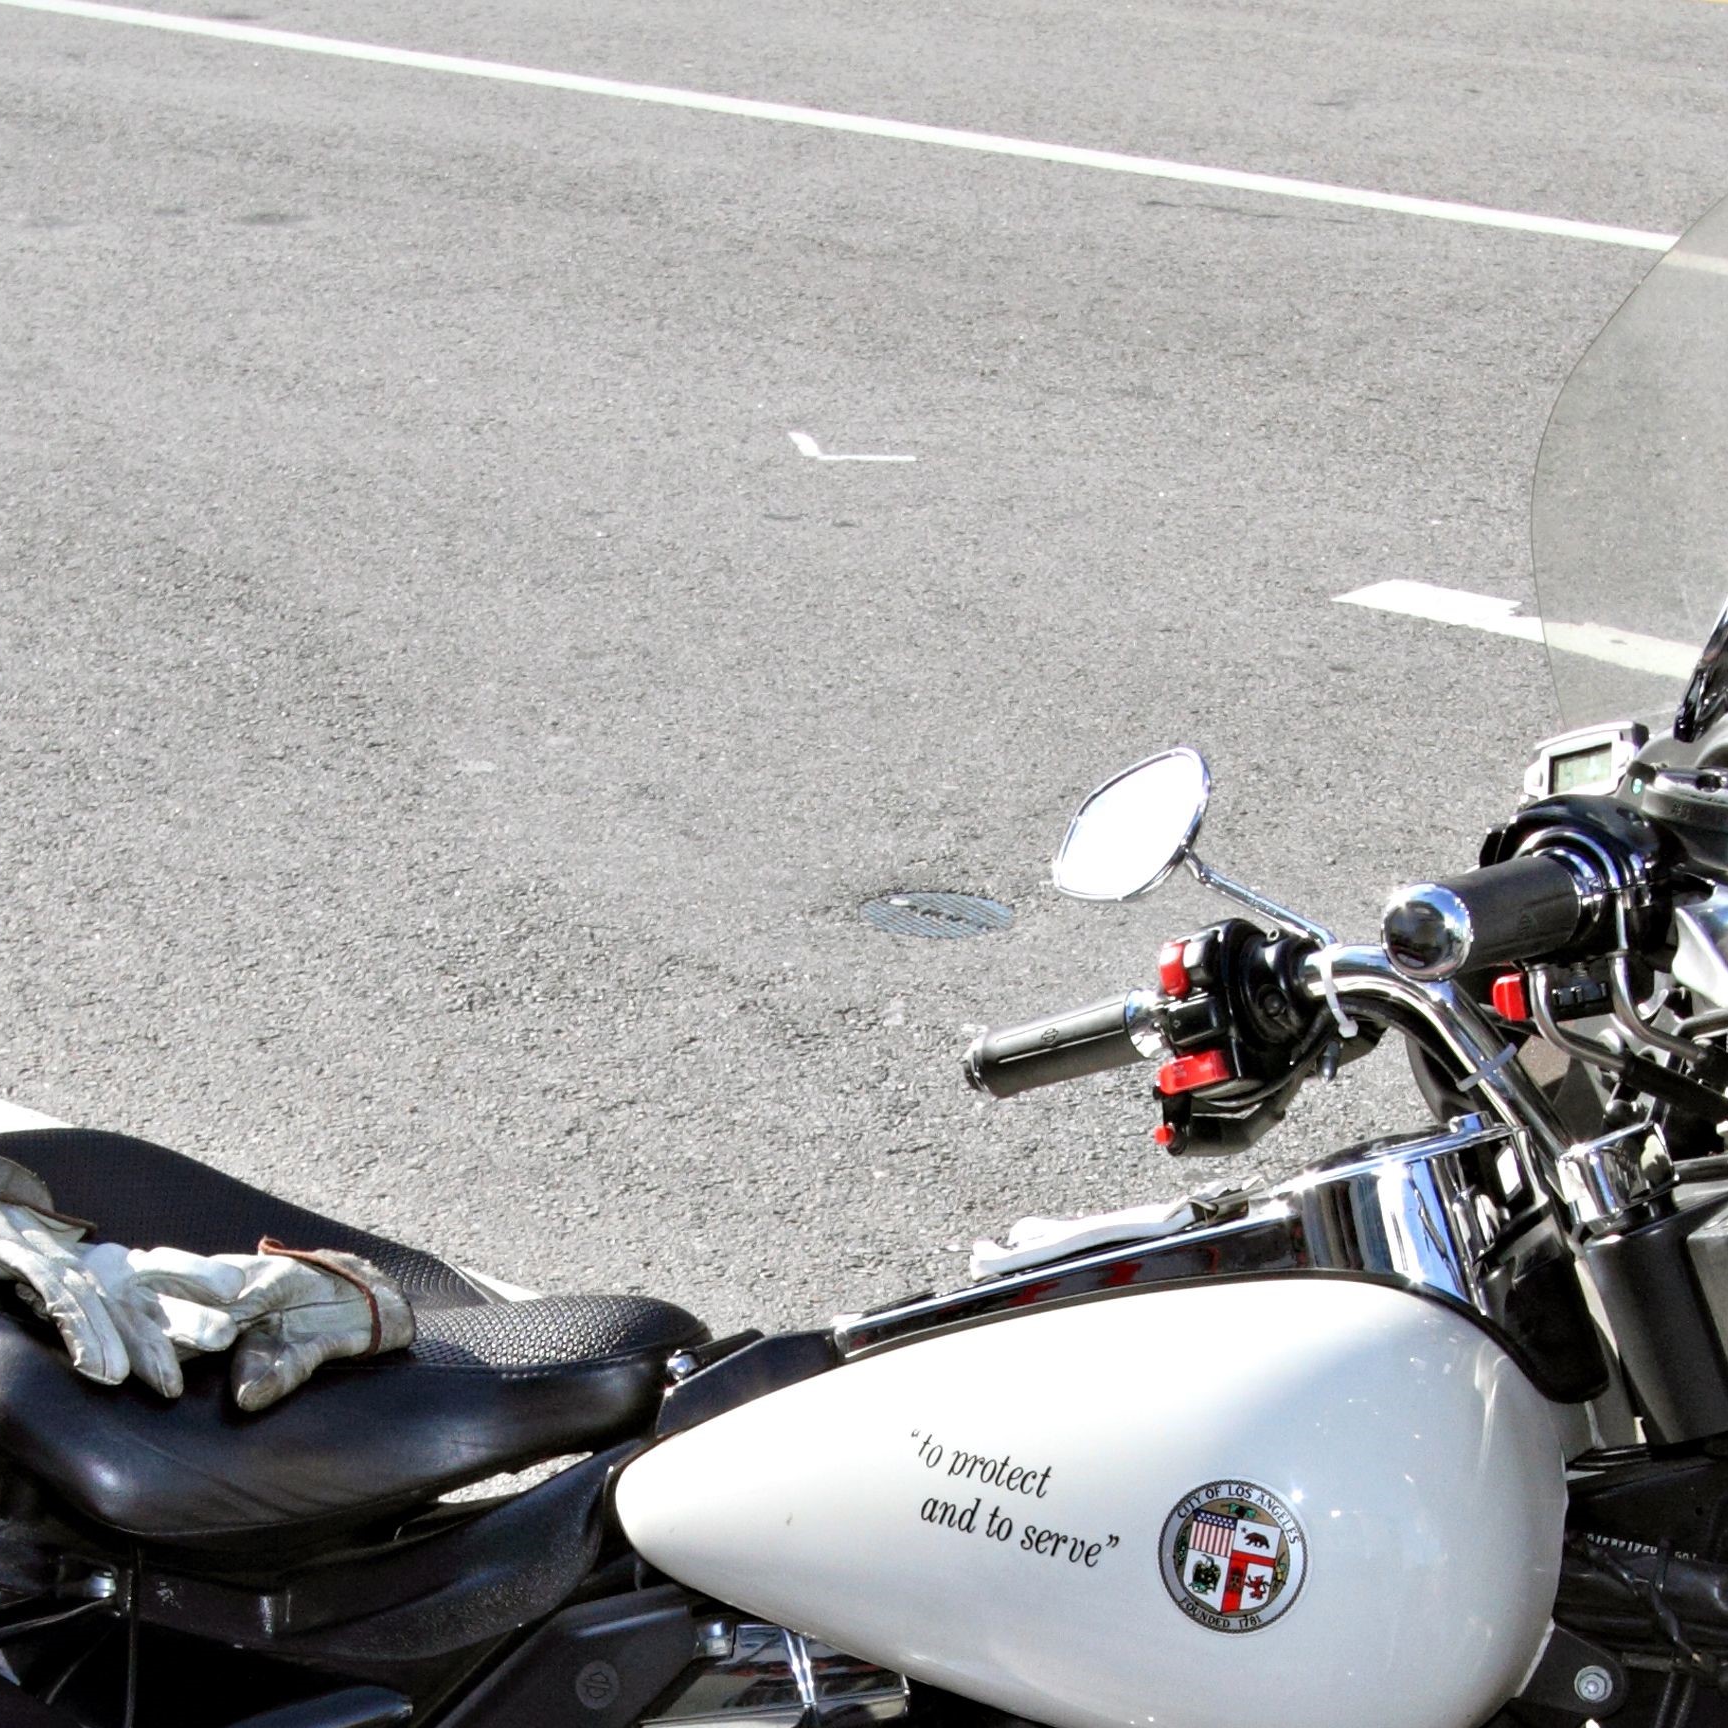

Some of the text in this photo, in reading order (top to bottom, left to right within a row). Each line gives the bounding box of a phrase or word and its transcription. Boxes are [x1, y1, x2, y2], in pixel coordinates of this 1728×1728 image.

[947, 1450, 1052, 1498] protect
[921, 1498, 981, 1533] and
[986, 1506, 1013, 1541] to
[1177, 1484, 1300, 1544] CITY OF LOS ANGELES
[1178, 1596, 1262, 1630] FOUNDED 1781
